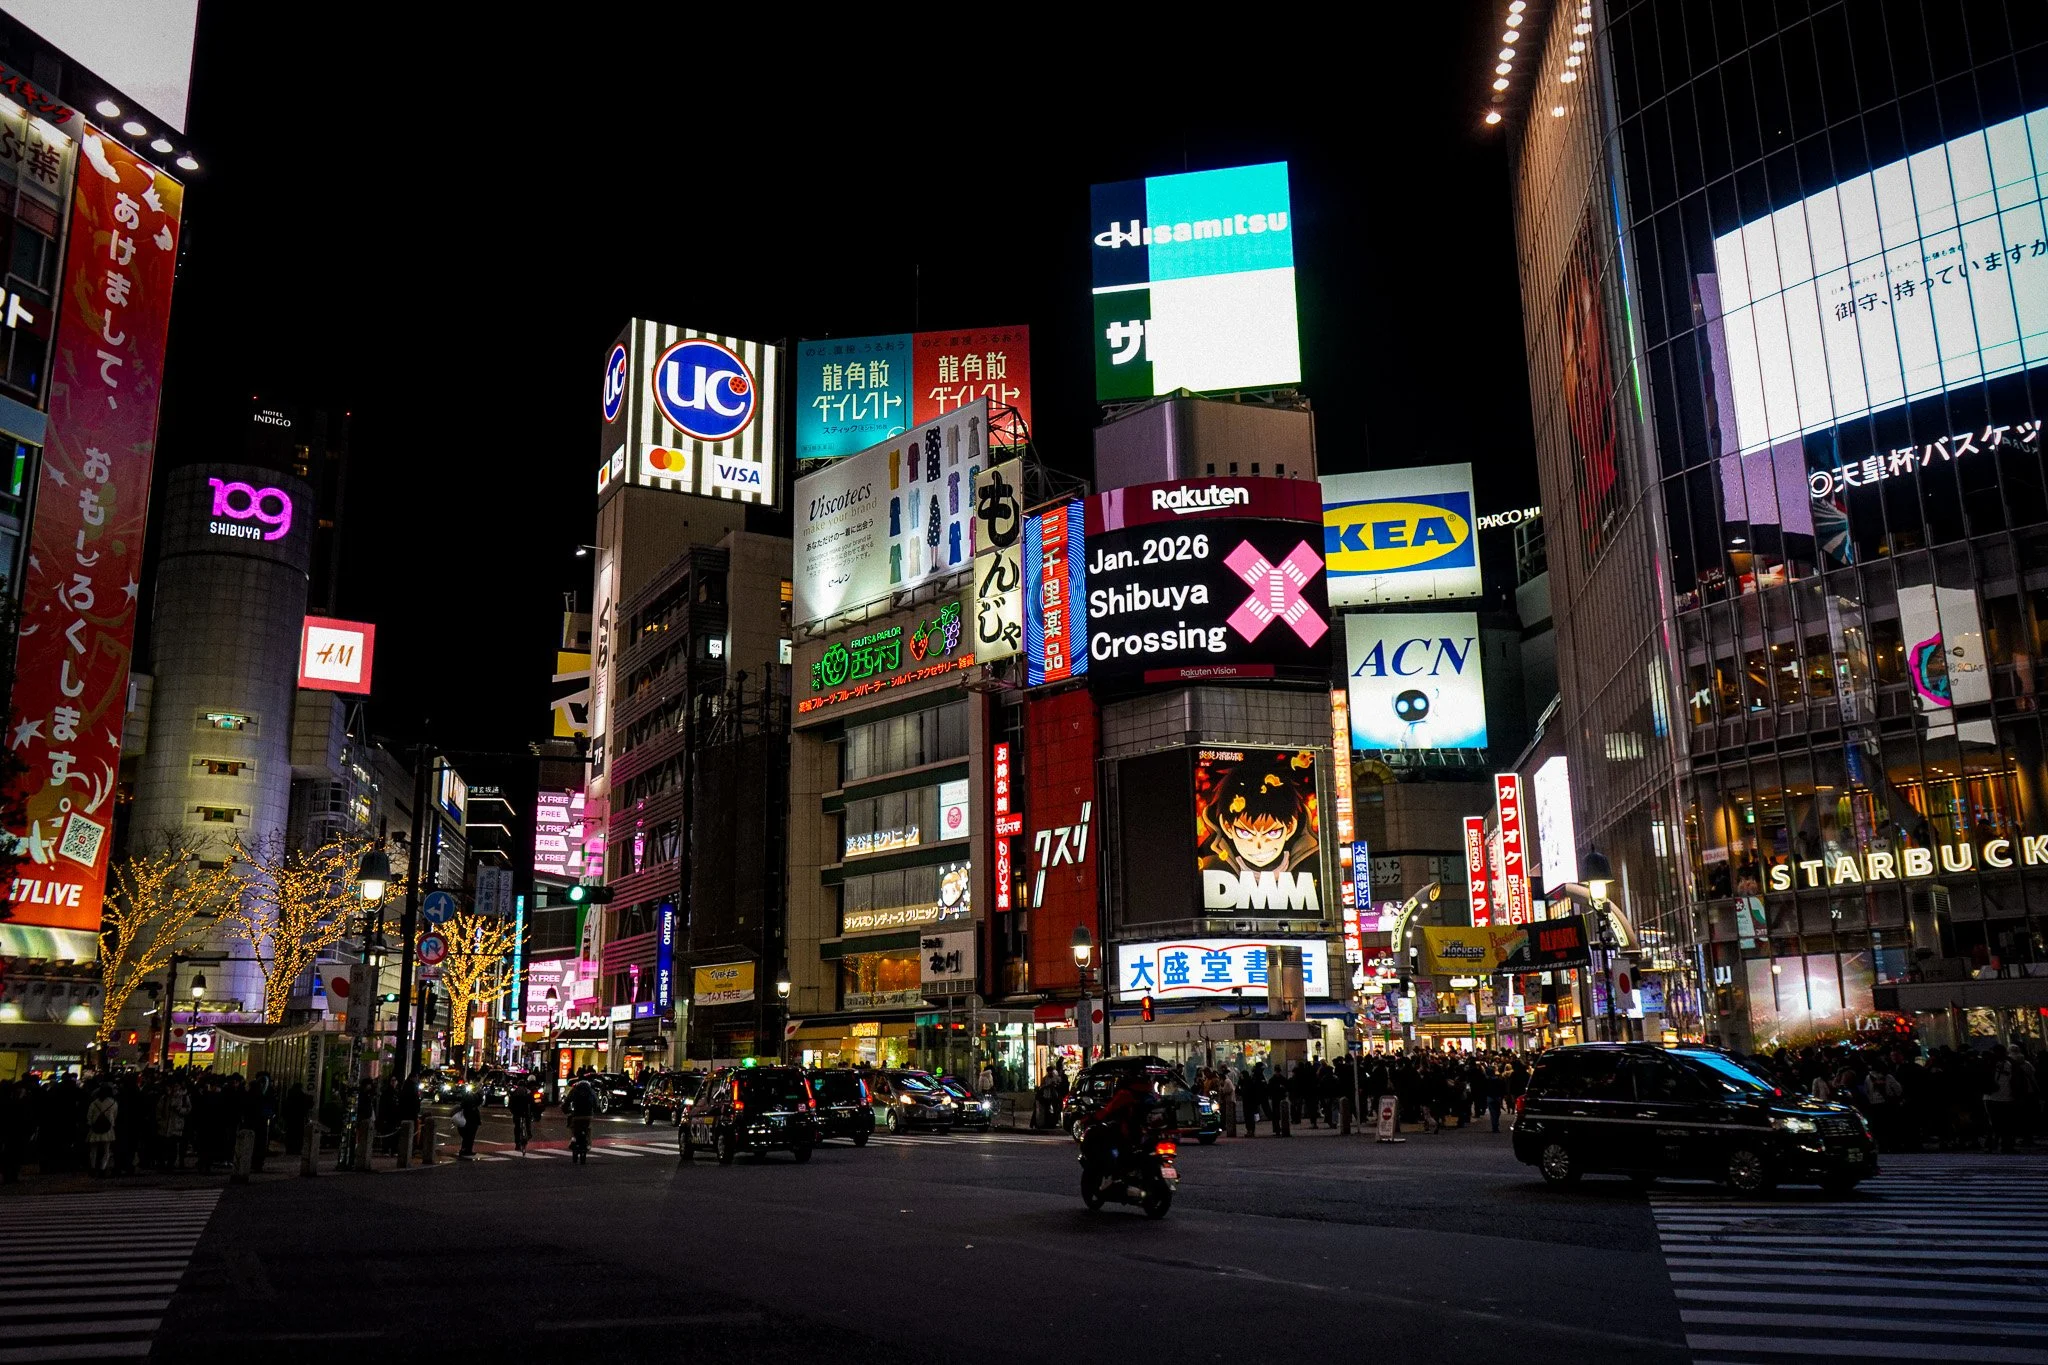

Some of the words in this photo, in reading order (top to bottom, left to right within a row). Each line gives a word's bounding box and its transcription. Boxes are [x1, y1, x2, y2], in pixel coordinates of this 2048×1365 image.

[1094, 212, 1287, 248] Hisamitsu
[0, 287, 33, 329] ト
[822, 359, 890, 391] 龍角散
[939, 351, 1007, 384] 龍角散
[254, 414, 291, 428] INDIGO
[263, 409, 283, 418] HOTEL
[812, 391, 902, 423] ダイレクト
[718, 464, 760, 485] VISA
[209, 477, 293, 541] 109
[810, 483, 871, 521] Viscotecs
[1152, 485, 1249, 513] Rakuten
[210, 522, 261, 540] SHIBUYA
[803, 523, 825, 537] make
[851, 497, 877, 516] brand
[1477, 510, 1521, 530] PARCO
[1325, 516, 1457, 553] KEA
[978, 470, 1021, 651] もんじゃ
[1042, 515, 1063, 671] 三千里薬品
[1090, 583, 1208, 618] Shibuya
[316, 643, 354, 667] H&M
[1092, 621, 1227, 661] Crossing
[851, 639, 901, 680] 西村
[1181, 668, 1211, 678] Rakuten
[1212, 667, 1237, 675] Vision
[1351, 638, 1475, 677] ACN
[548, 796, 568, 804] FREE
[1468, 829, 1478, 846] BIG
[1500, 786, 1521, 865] カラオケ
[545, 854, 566, 862] FREE
[1470, 847, 1481, 872] ECHO
[1771, 835, 2048, 891] STARBUCK
[9, 878, 83, 907] 17LIVE
[1203, 870, 1320, 911] DMM
[1508, 875, 1519, 895] BIG
[1511, 896, 1522, 925] ECHO
[663, 912, 671, 945] MIZUHO
[660, 970, 668, 1006] みずほ銀行
[708, 992, 721, 1000] TAX
[723, 990, 740, 1000] FREE
[552, 1012, 608, 1030] グルメタウン
[307, 1035, 319, 1091] SMOKING
